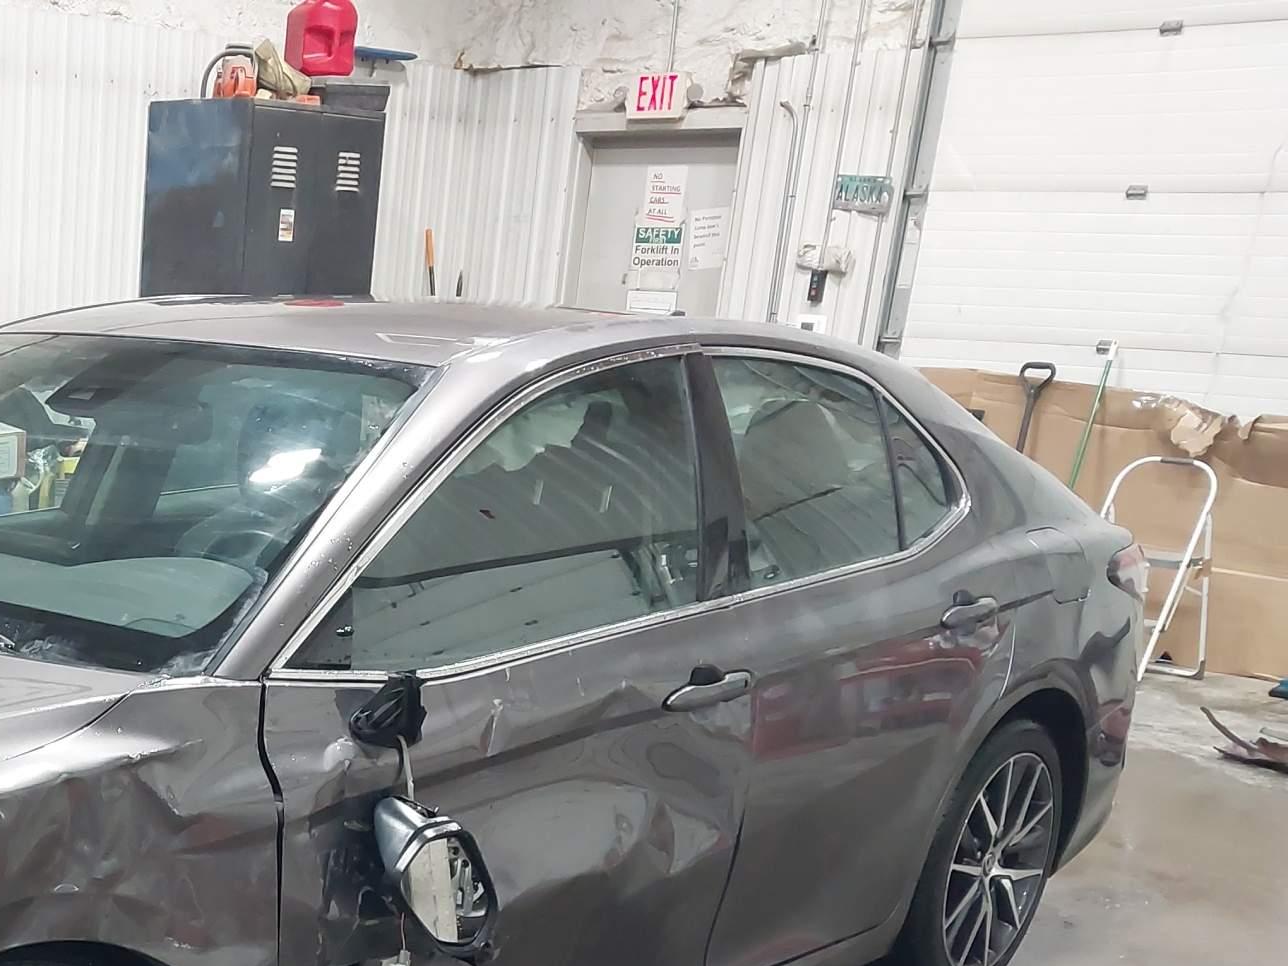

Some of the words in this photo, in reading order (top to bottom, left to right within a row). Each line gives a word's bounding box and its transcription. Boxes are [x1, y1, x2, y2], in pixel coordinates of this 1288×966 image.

[637, 75, 678, 111] EXIT
[836, 184, 882, 203] ALASKA
[638, 228, 681, 239] SAFETY
[635, 245, 668, 254] Forklift
[671, 246, 680, 255] In
[632, 256, 679, 268] Operation
